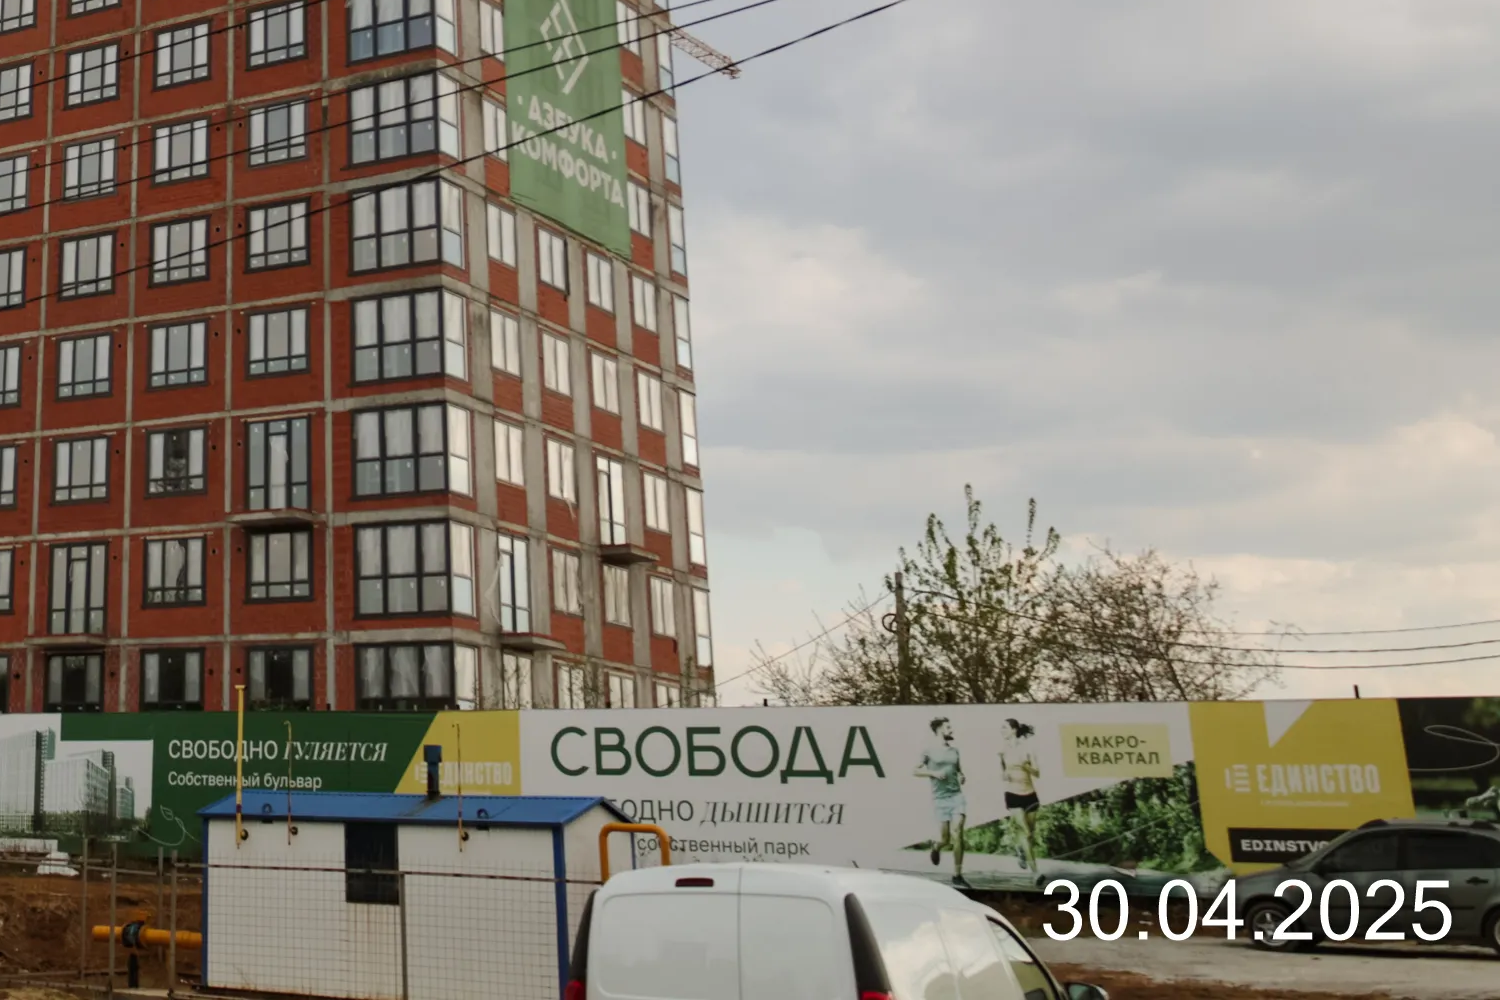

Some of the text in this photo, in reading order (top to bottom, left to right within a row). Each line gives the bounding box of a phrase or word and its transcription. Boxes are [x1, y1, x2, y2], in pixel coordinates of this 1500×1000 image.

[528, 95, 609, 164] АЗБУКА
[511, 120, 625, 208] КОМФОРТА
[168, 739, 388, 762] СВОБОДНО ГУЛЯЕТСЯ
[1075, 735, 1147, 748] МАКРО-
[551, 725, 886, 784] СВОБОДА
[1077, 751, 1160, 765] КВАРТАЛ
[168, 771, 322, 791] Собственный бульвар
[1256, 763, 1381, 796] ЕДИНСТВО
[700, 800, 845, 826] ДЫШИТСЯ
[764, 839, 810, 856] парк
